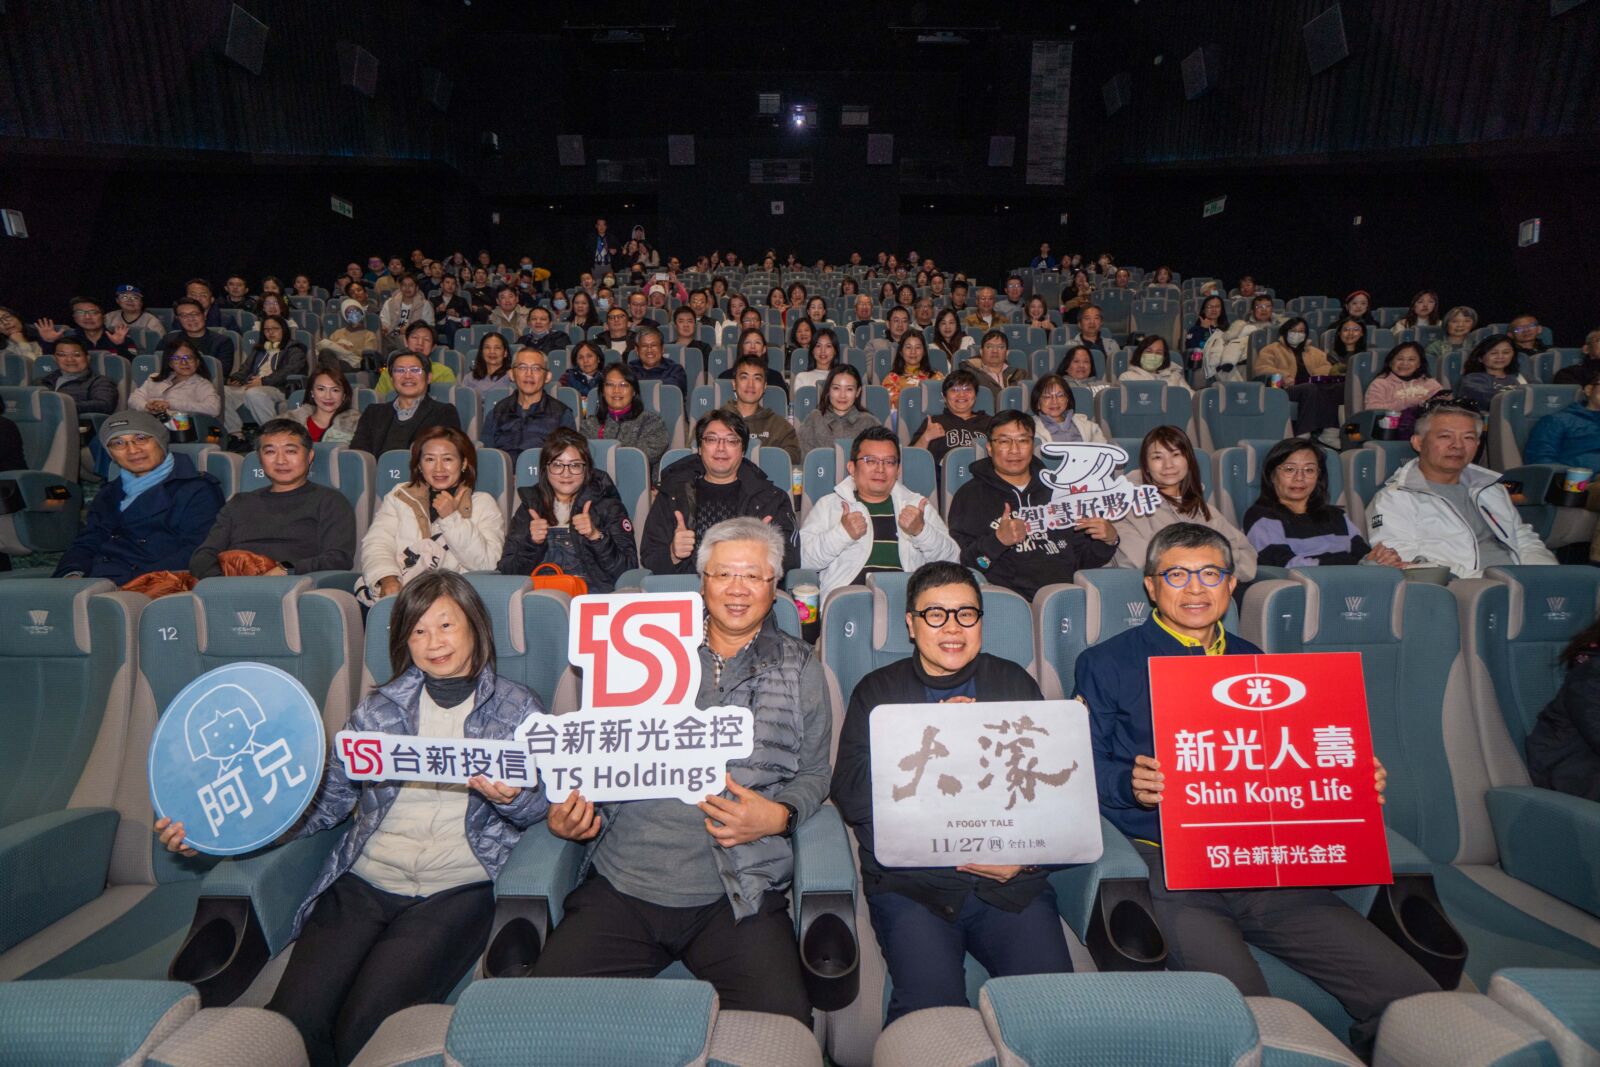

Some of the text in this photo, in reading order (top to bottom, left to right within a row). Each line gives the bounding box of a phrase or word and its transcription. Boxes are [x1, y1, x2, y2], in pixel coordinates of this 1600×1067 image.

[252, 468, 265, 478] 13
[389, 469, 400, 478] 12
[527, 466, 538, 475] 11
[817, 466, 824, 477] 9
[1020, 487, 1159, 532] 智慧好夥伴
[158, 626, 178, 641] 12
[844, 621, 854, 637] 9
[1060, 617, 1072, 633] 8
[1247, 678, 1272, 705] 光
[525, 714, 743, 755] 台新新光金控
[1175, 725, 1356, 772] 新光人壽
[390, 743, 528, 781] 台新投信
[892, 715, 1078, 810] 大濛
[197, 738, 307, 838] 阿兄
[552, 762, 717, 792] TS Holdings
[1185, 778, 1352, 809] Shin Kong Life
[947, 819, 1014, 828] A FOGGY TALE
[931, 837, 984, 853] 11/27
[1008, 838, 1046, 849] 全台上映
[1233, 844, 1347, 866] 台新新光金控
